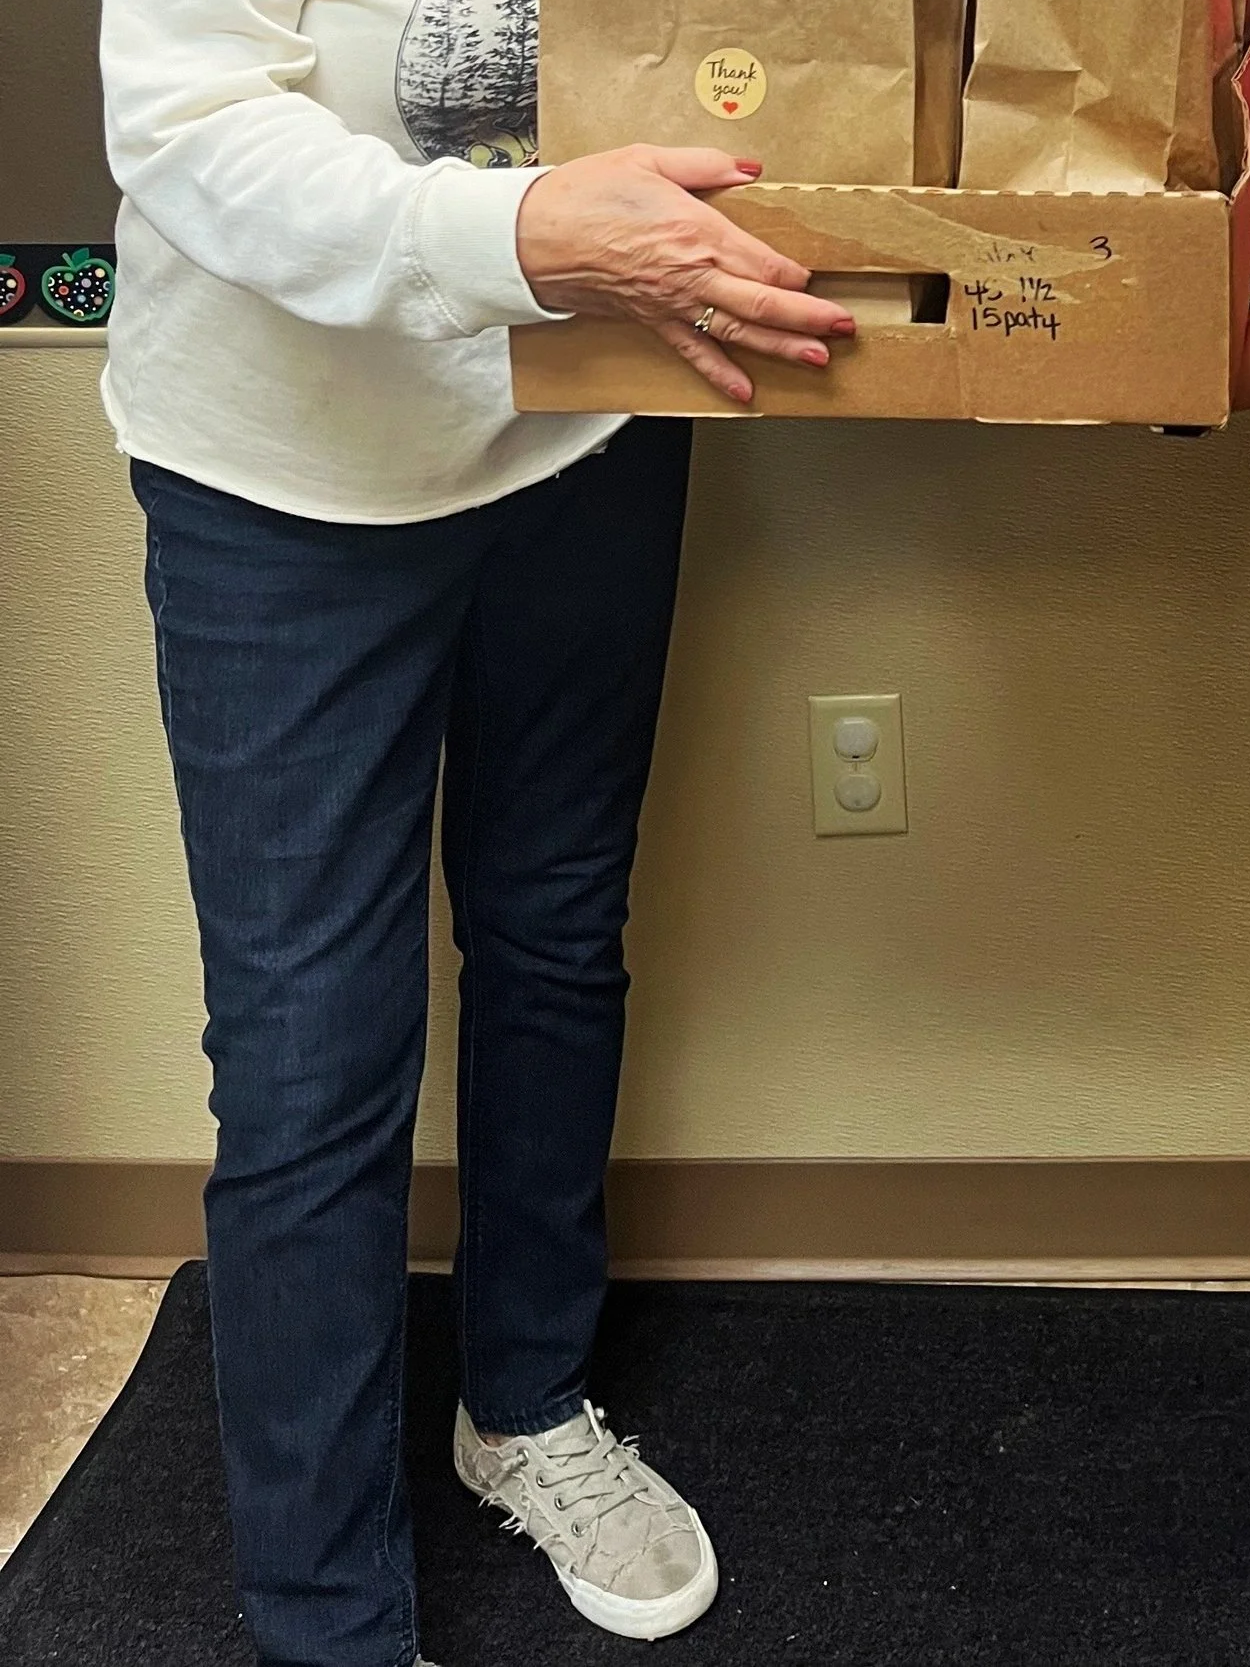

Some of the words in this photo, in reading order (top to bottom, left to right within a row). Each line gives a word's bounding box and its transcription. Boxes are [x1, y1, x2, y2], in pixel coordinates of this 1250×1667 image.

[706, 58, 757, 81] Thank
[713, 82, 747, 102] you!
[1089, 236, 1112, 260] 3
